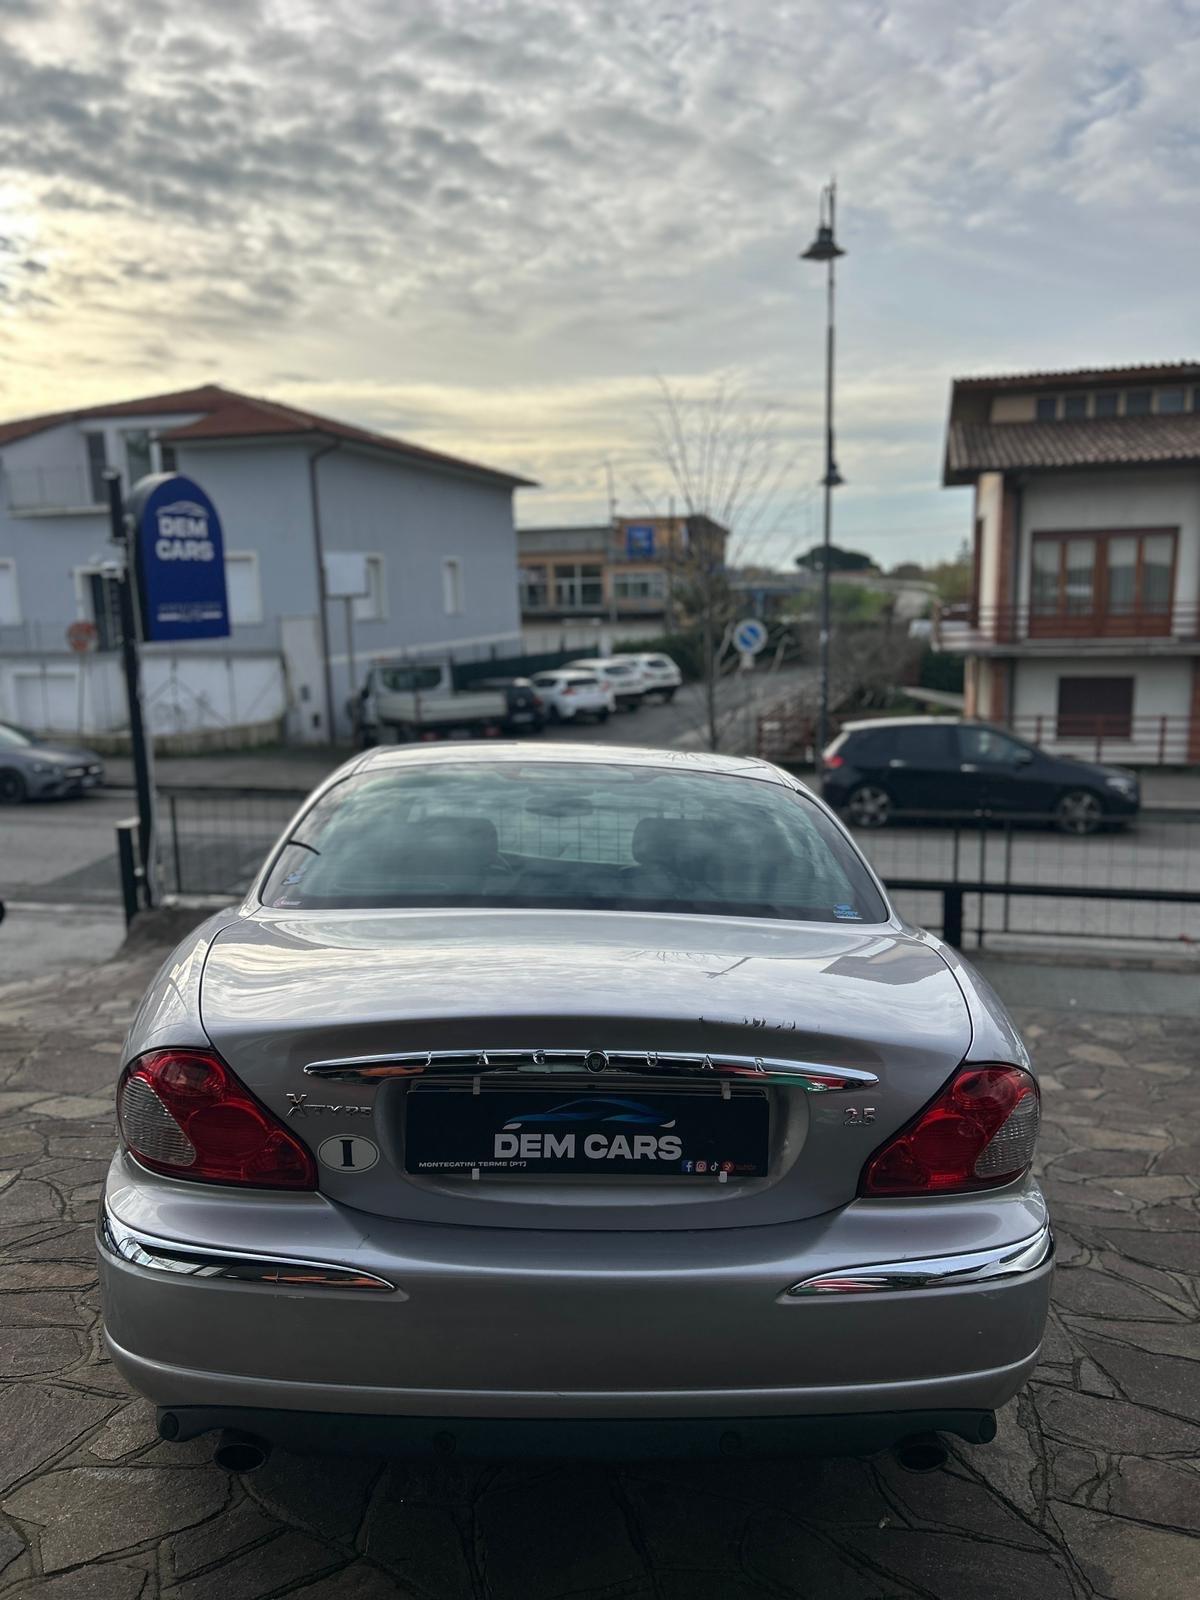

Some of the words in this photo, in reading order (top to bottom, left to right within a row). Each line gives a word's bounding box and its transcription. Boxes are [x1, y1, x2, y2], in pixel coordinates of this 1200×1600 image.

[158, 515, 208, 539] DEM
[155, 538, 215, 562] CARS
[424, 1049, 766, 1073] JAGUAR
[494, 1133, 576, 1159] DEM
[583, 1133, 683, 1161] CARS
[418, 1160, 476, 1168] MONTECATINI
[478, 1160, 508, 1168] TERME
